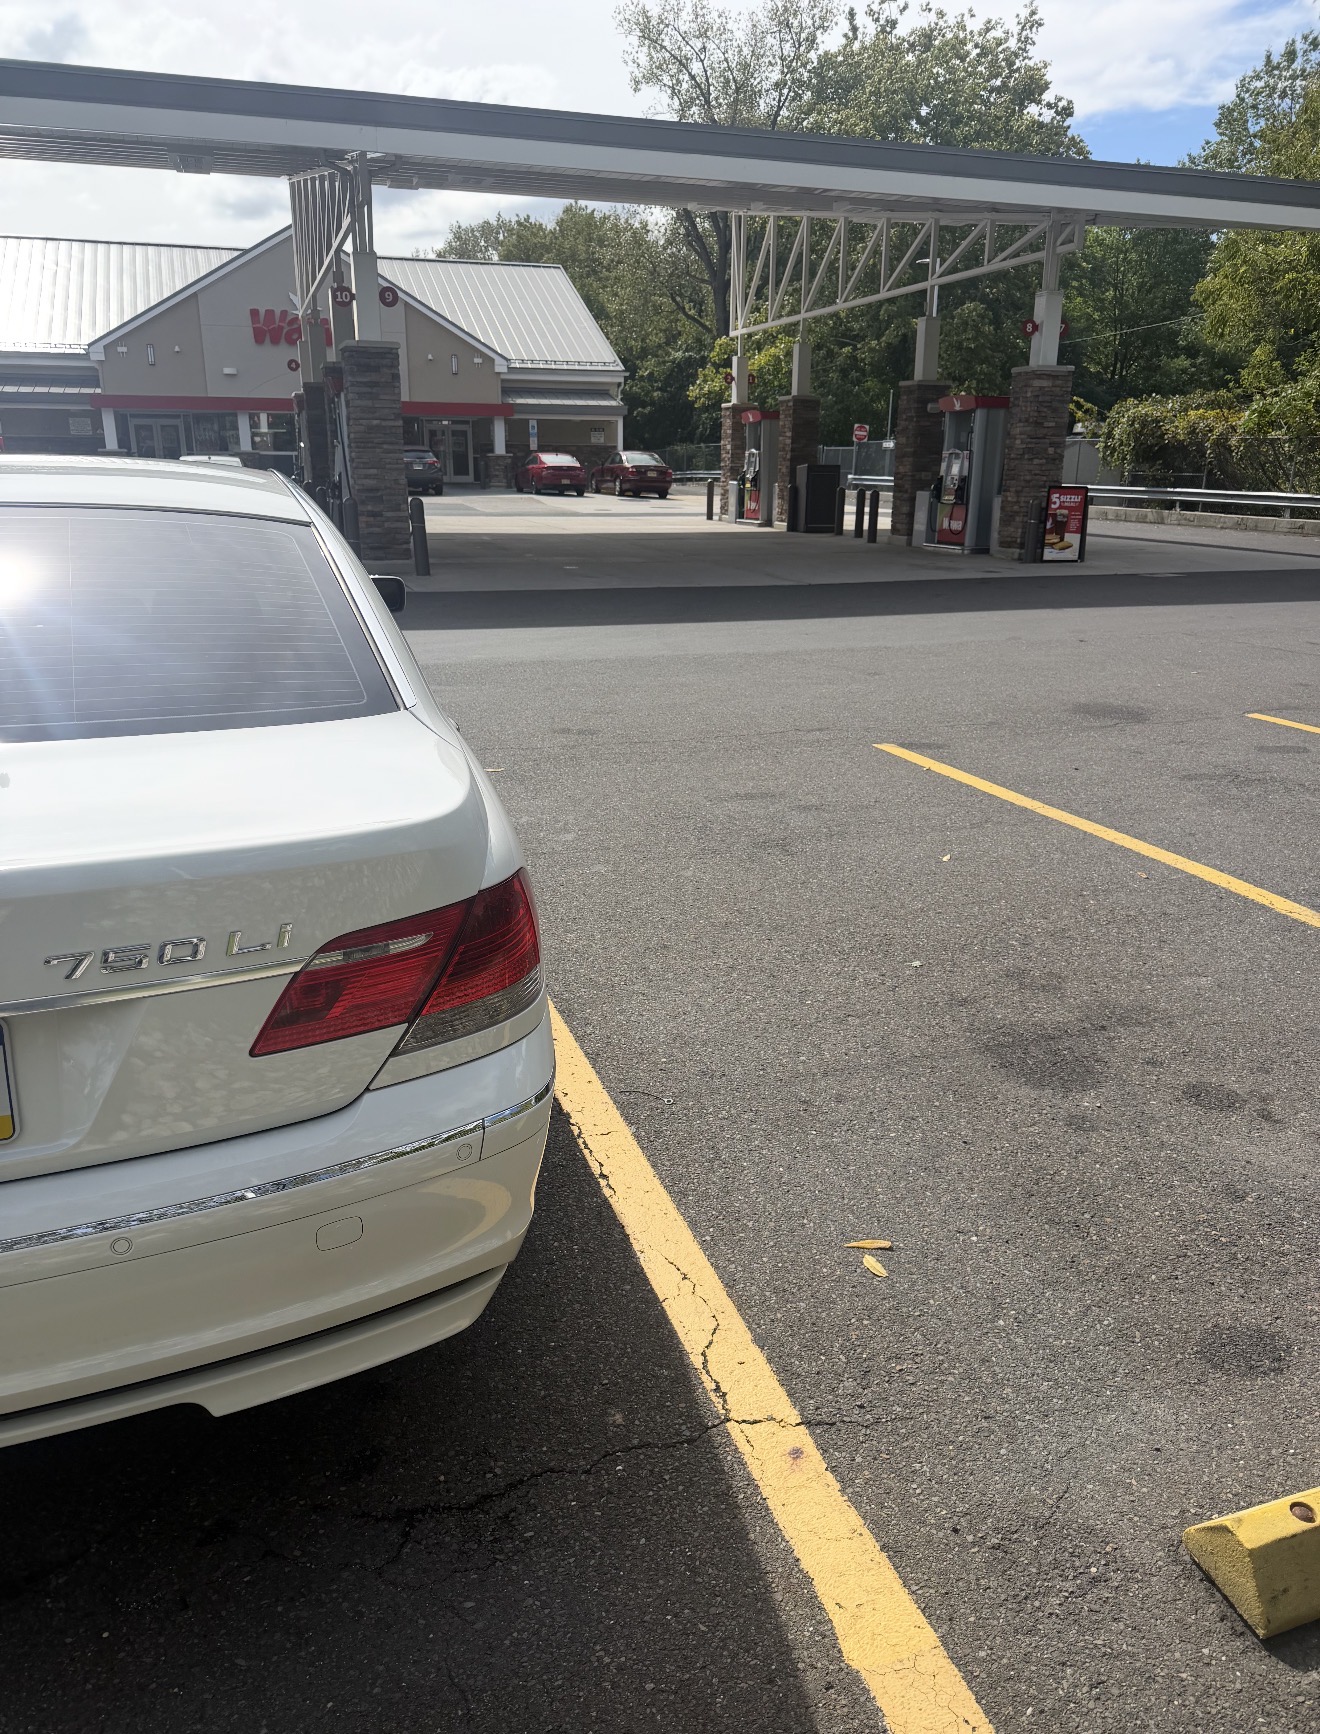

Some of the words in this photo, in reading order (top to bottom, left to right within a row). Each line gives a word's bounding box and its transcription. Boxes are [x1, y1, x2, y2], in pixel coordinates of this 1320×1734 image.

[335, 291, 350, 302] 10
[384, 291, 393, 302] 9
[1026, 323, 1033, 332] 8
[1059, 323, 1065, 332] 7
[44, 937, 206, 980] 750
